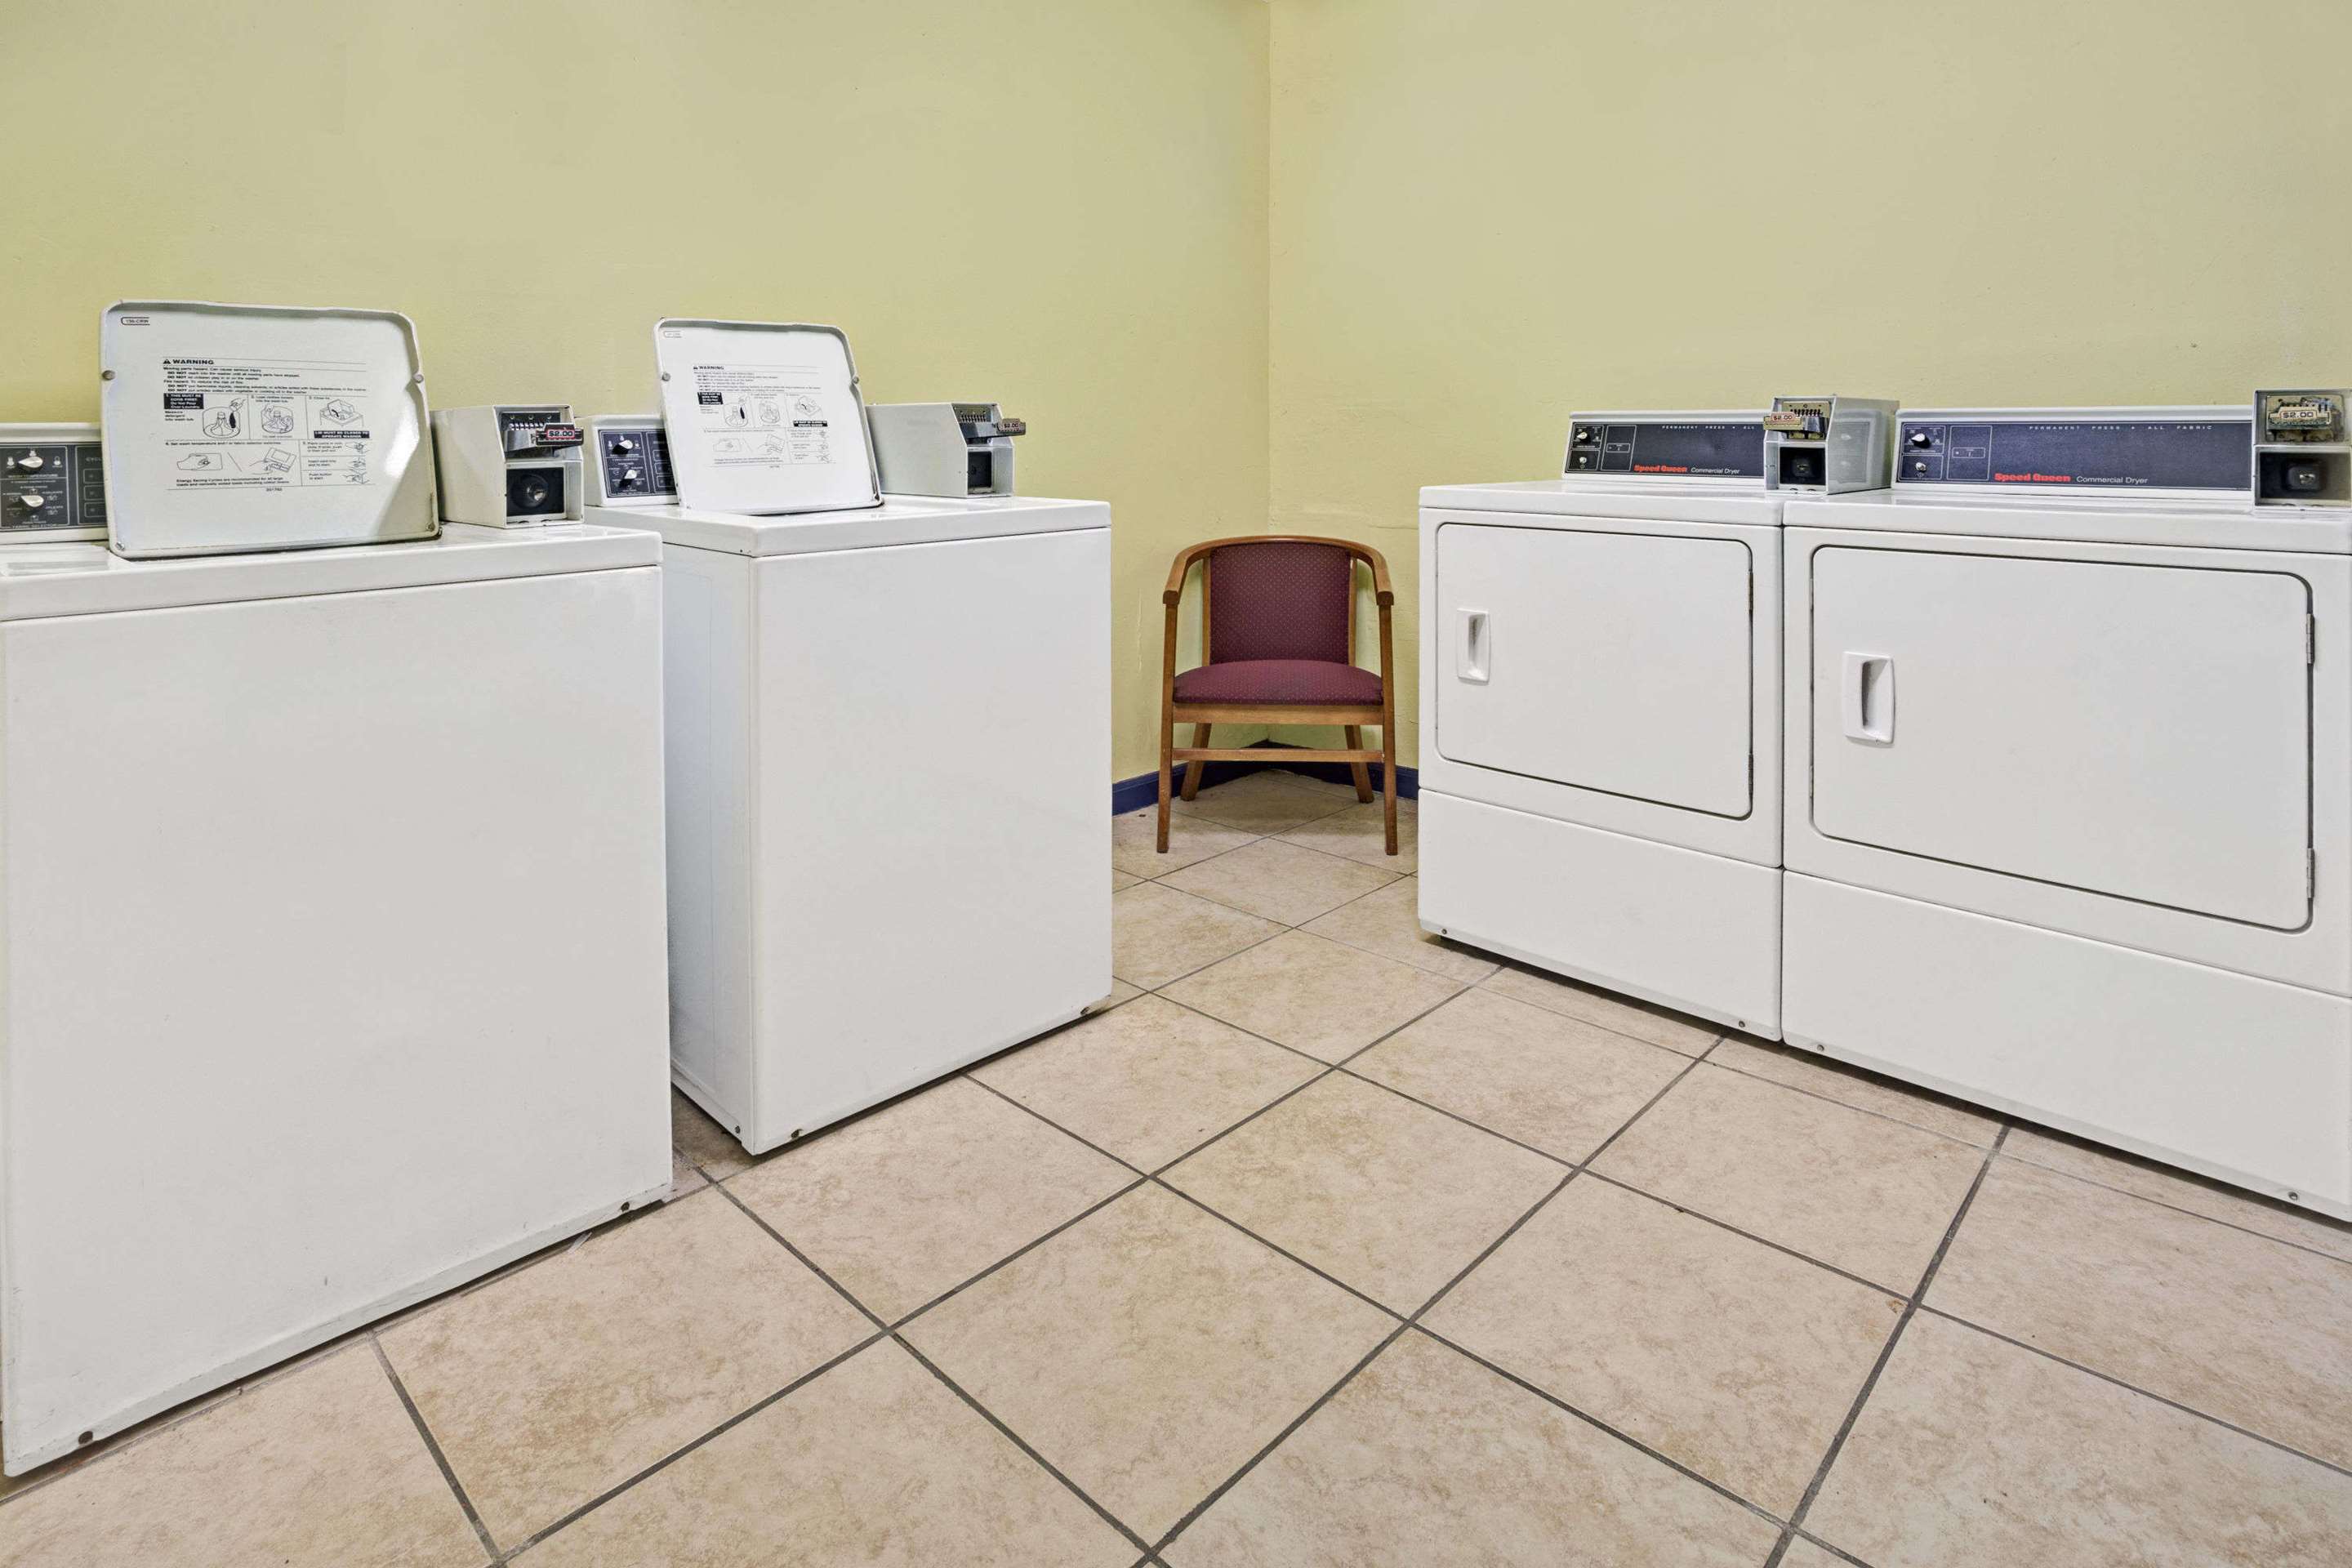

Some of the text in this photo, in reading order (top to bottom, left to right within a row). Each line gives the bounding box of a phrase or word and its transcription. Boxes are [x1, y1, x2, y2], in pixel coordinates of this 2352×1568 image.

[1634, 465, 1660, 474] Speed
[1994, 473, 2148, 485] Speed Queen Commercial Dryer
